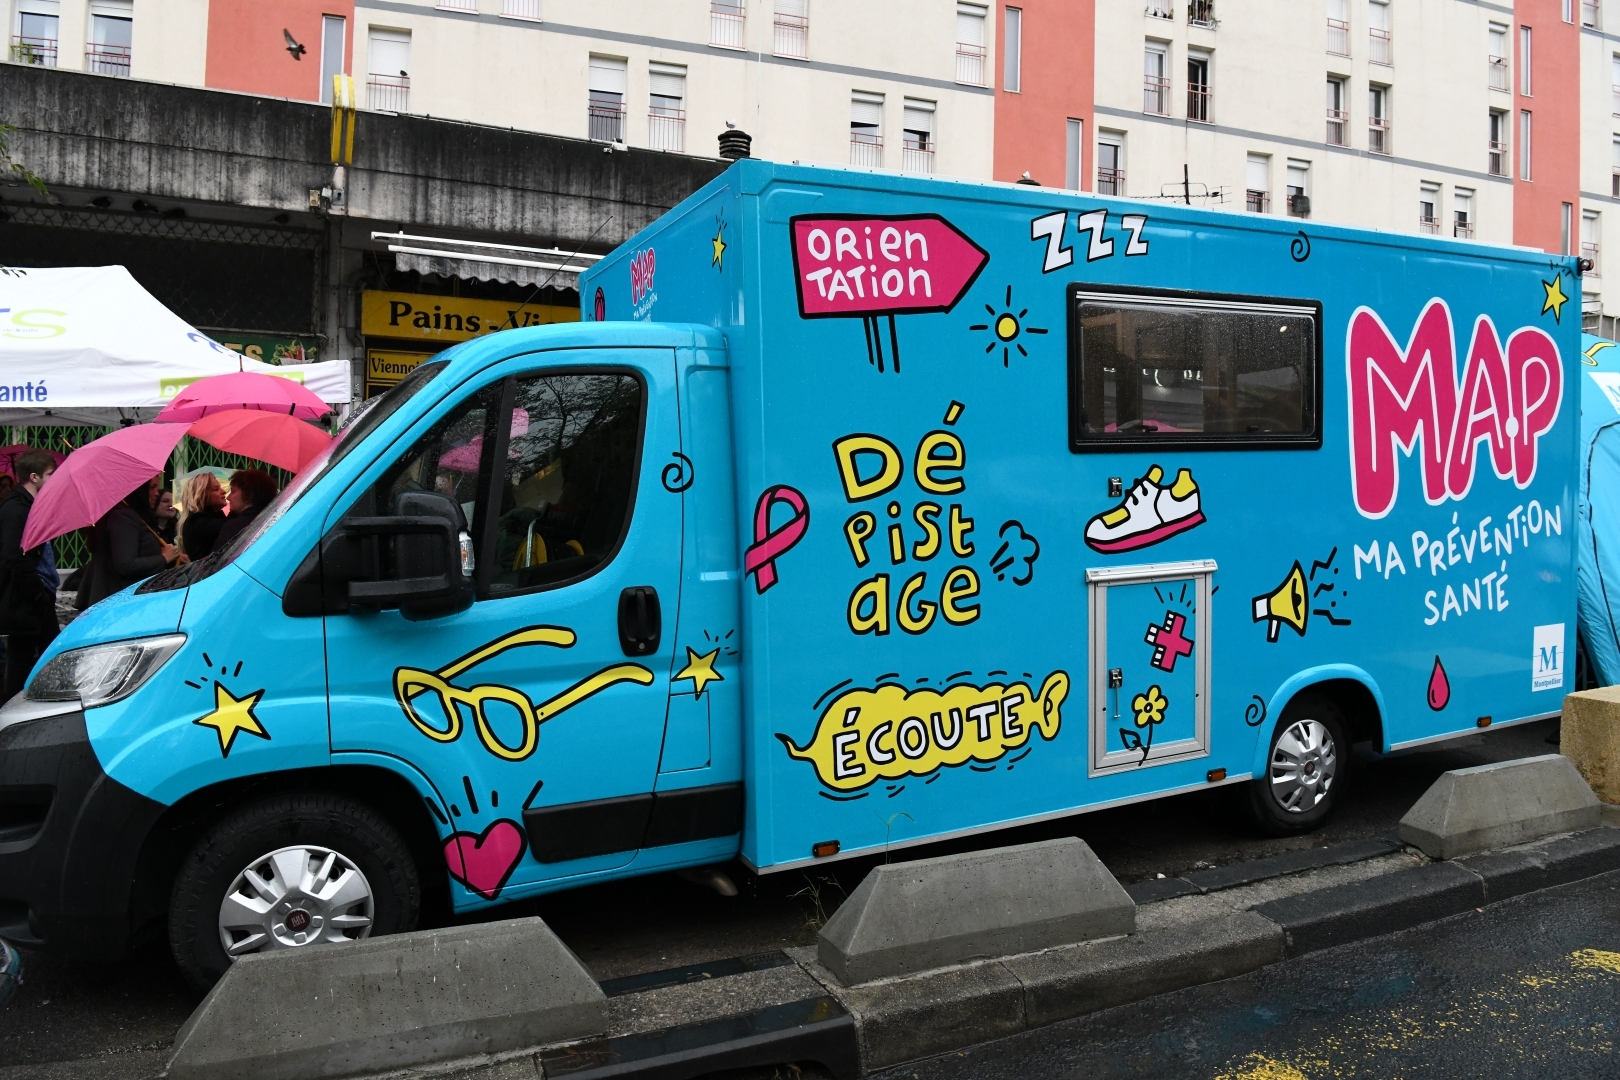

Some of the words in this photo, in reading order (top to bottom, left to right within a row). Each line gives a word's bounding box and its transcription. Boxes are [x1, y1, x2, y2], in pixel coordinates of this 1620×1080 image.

[630, 247, 656, 307] MAP
[389, 301, 481, 332] Pains
[507, 310, 557, 330] Vi
[1346, 296, 1564, 520] MAP
[832, 400, 966, 503] Dé
[1354, 539, 1406, 580] MA
[1424, 560, 1509, 625] SANTÉ
[1533, 678, 1562, 688] Montpellier
[1538, 645, 1558, 672] M
[832, 692, 1025, 780] ÉCOUTE
[291, 913, 306, 928] FIAT
